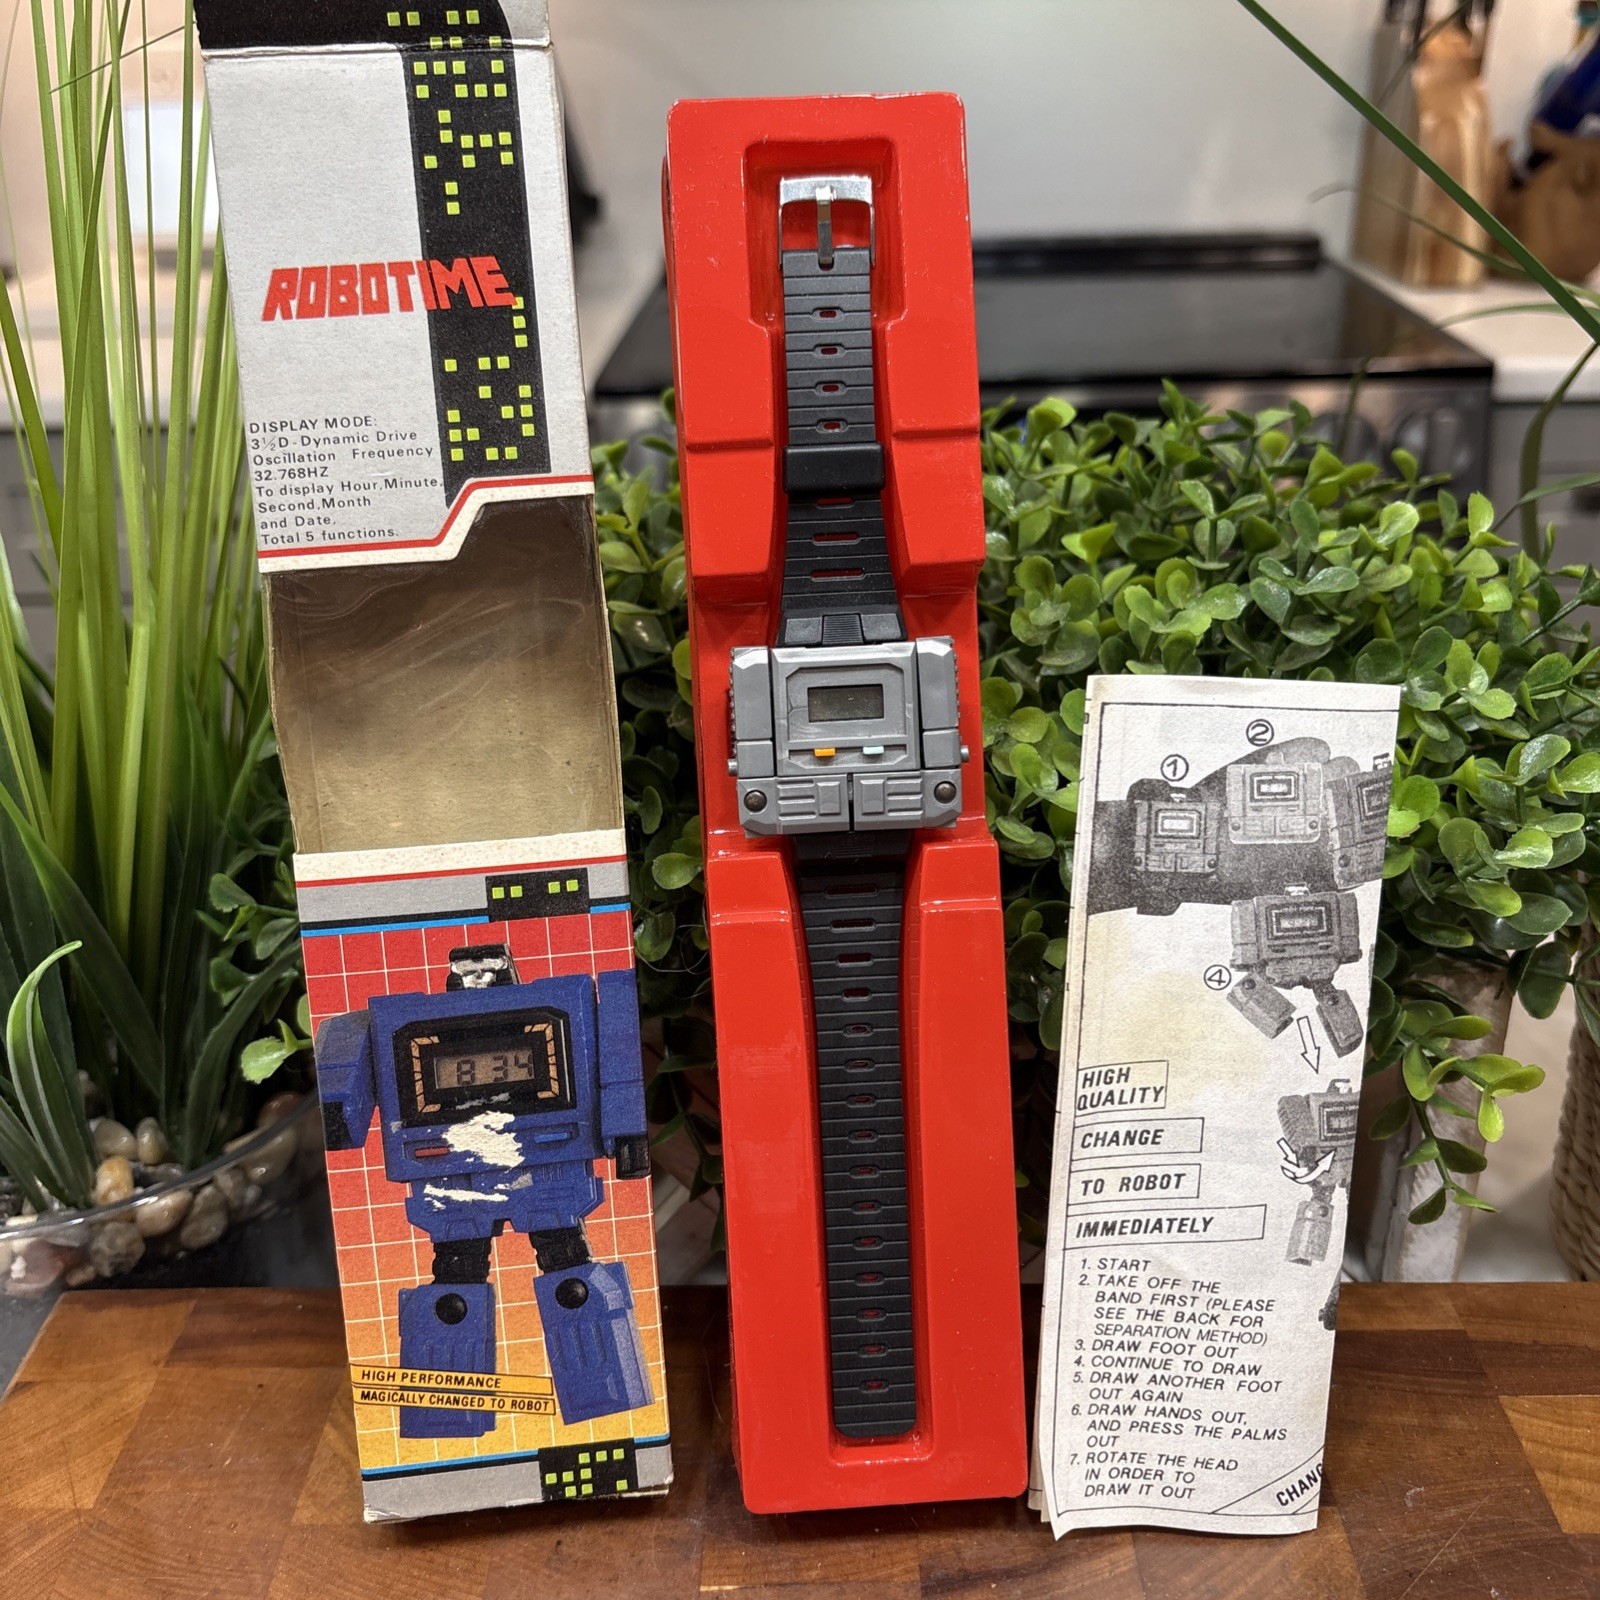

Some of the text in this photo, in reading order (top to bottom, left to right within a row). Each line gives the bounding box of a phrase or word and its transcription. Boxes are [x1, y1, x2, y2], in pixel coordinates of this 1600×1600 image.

[261, 256, 519, 322] ROBOTIME
[250, 415, 378, 434] DISPLAY MODE:
[376, 430, 418, 442] Drive
[253, 447, 434, 466] Oscillation Frequency
[254, 467, 329, 482] 32.768HZ
[256, 486, 274, 498] To
[279, 483, 334, 498] display
[260, 517, 287, 530] and
[261, 527, 400, 546] Total 5 functions.
[1081, 1067, 1131, 1089] HIGH
[1077, 1086, 1164, 1111] QUALITY
[1080, 1129, 1165, 1149] CHANGE
[1081, 1173, 1186, 1196] TO ROBOT
[1075, 1216, 1214, 1239] IMMEDIATELY
[1081, 1257, 1151, 1272] 1. START
[1078, 1274, 1221, 1294] 2. TAKE OFF THE
[1095, 1291, 1275, 1312] BAND FIRST (PLEASE
[1094, 1307, 1264, 1328] SEE THE BACK FOR
[1094, 1323, 1268, 1347] SEPARATION METHOD)
[1074, 1339, 1239, 1359] 3. DRAW FOOT OUT
[1073, 1355, 1262, 1376] 4. CONTINUE TO DRAW
[361, 1370, 502, 1388] HIGH PERFORMANCE
[1073, 1371, 1283, 1393] 5. DRAW ANOTHER FOOT
[360, 1390, 549, 1412] MAGICALLY CHANGED TO ROBOT
[1089, 1387, 1184, 1403] OUT AGAIN
[1071, 1403, 1082, 1416] 6.
[1087, 1403, 1137, 1416] DRAW
[1144, 1405, 1202, 1421] HANDS
[1087, 1419, 1287, 1441] AND PRESS THE PALMS
[1086, 1435, 1120, 1448] OUT
[1070, 1451, 1238, 1471] 7. ROTATE THE HEAD
[1084, 1467, 1195, 1484] IN ORDER TO
[1084, 1483, 1196, 1499] DRAW IT OUT
